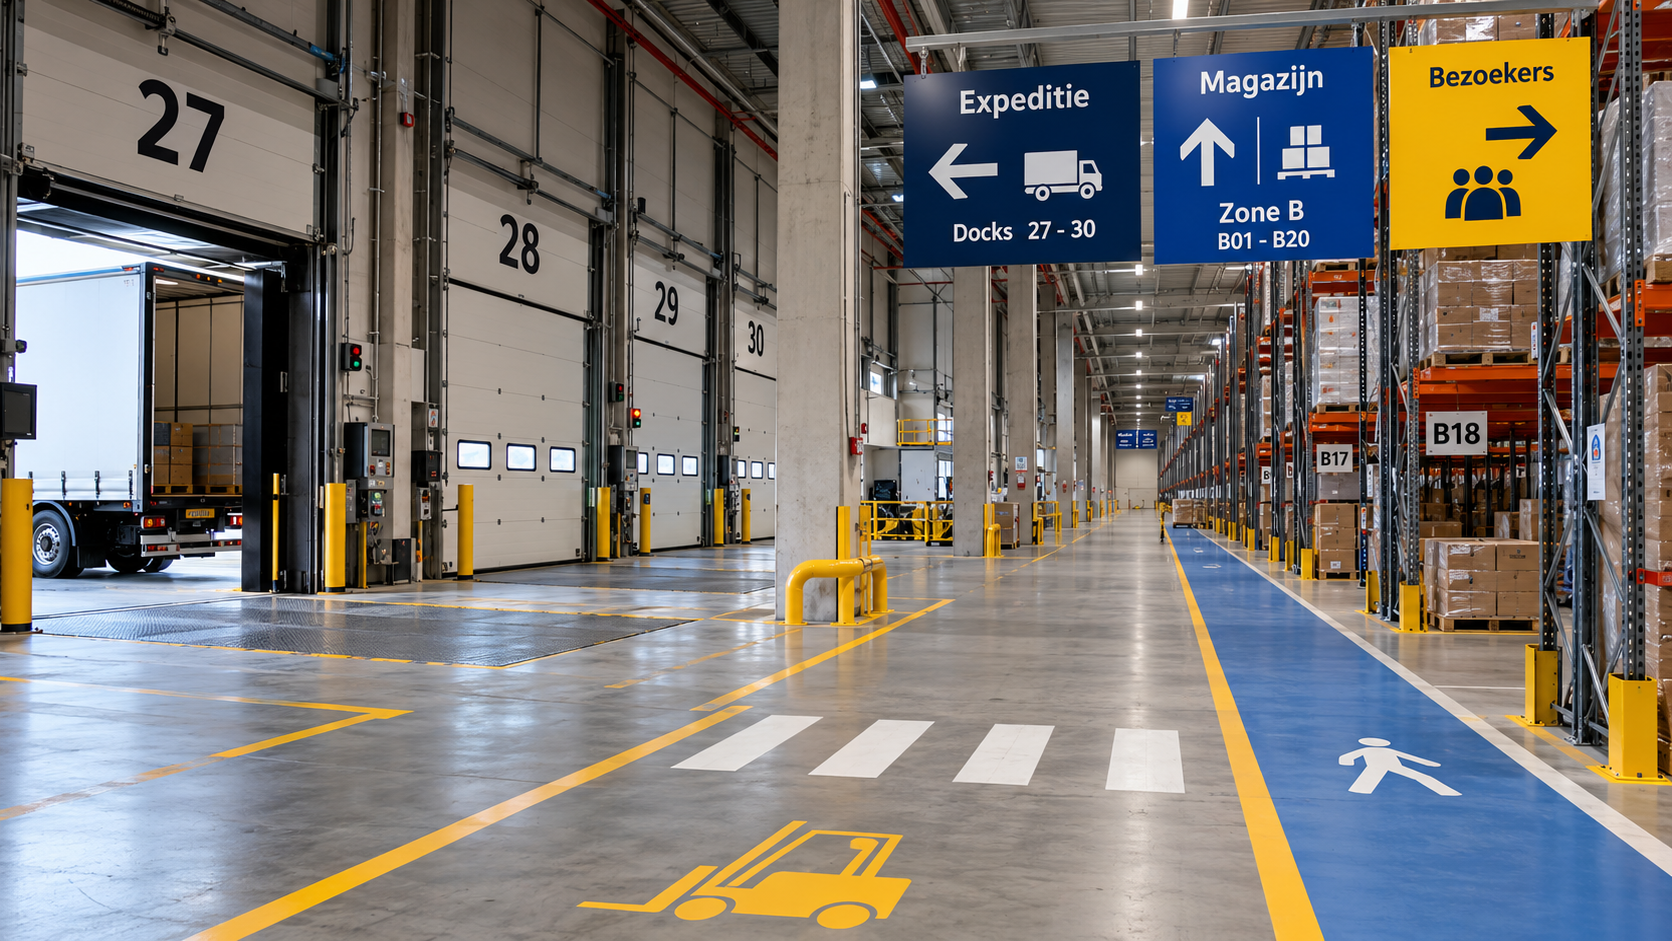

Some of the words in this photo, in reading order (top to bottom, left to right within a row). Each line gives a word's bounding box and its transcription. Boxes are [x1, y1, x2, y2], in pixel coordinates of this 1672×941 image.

[1200, 64, 1323, 99] Magazijn
[1429, 61, 1555, 88] Bezoekers
[960, 83, 1090, 119] Expeditie
[137, 78, 225, 173] 27
[1219, 202, 1281, 224] Zone
[1288, 199, 1304, 221] B
[499, 213, 540, 275] 28
[953, 221, 1013, 243] Docks
[1028, 220, 1052, 240] 27
[1070, 219, 1096, 239] 30
[1218, 231, 1252, 250] B01
[1273, 229, 1310, 249] B20
[654, 280, 679, 326] 29
[747, 320, 764, 357] 30
[1433, 422, 1481, 445] B18
[1320, 451, 1349, 466] B17
